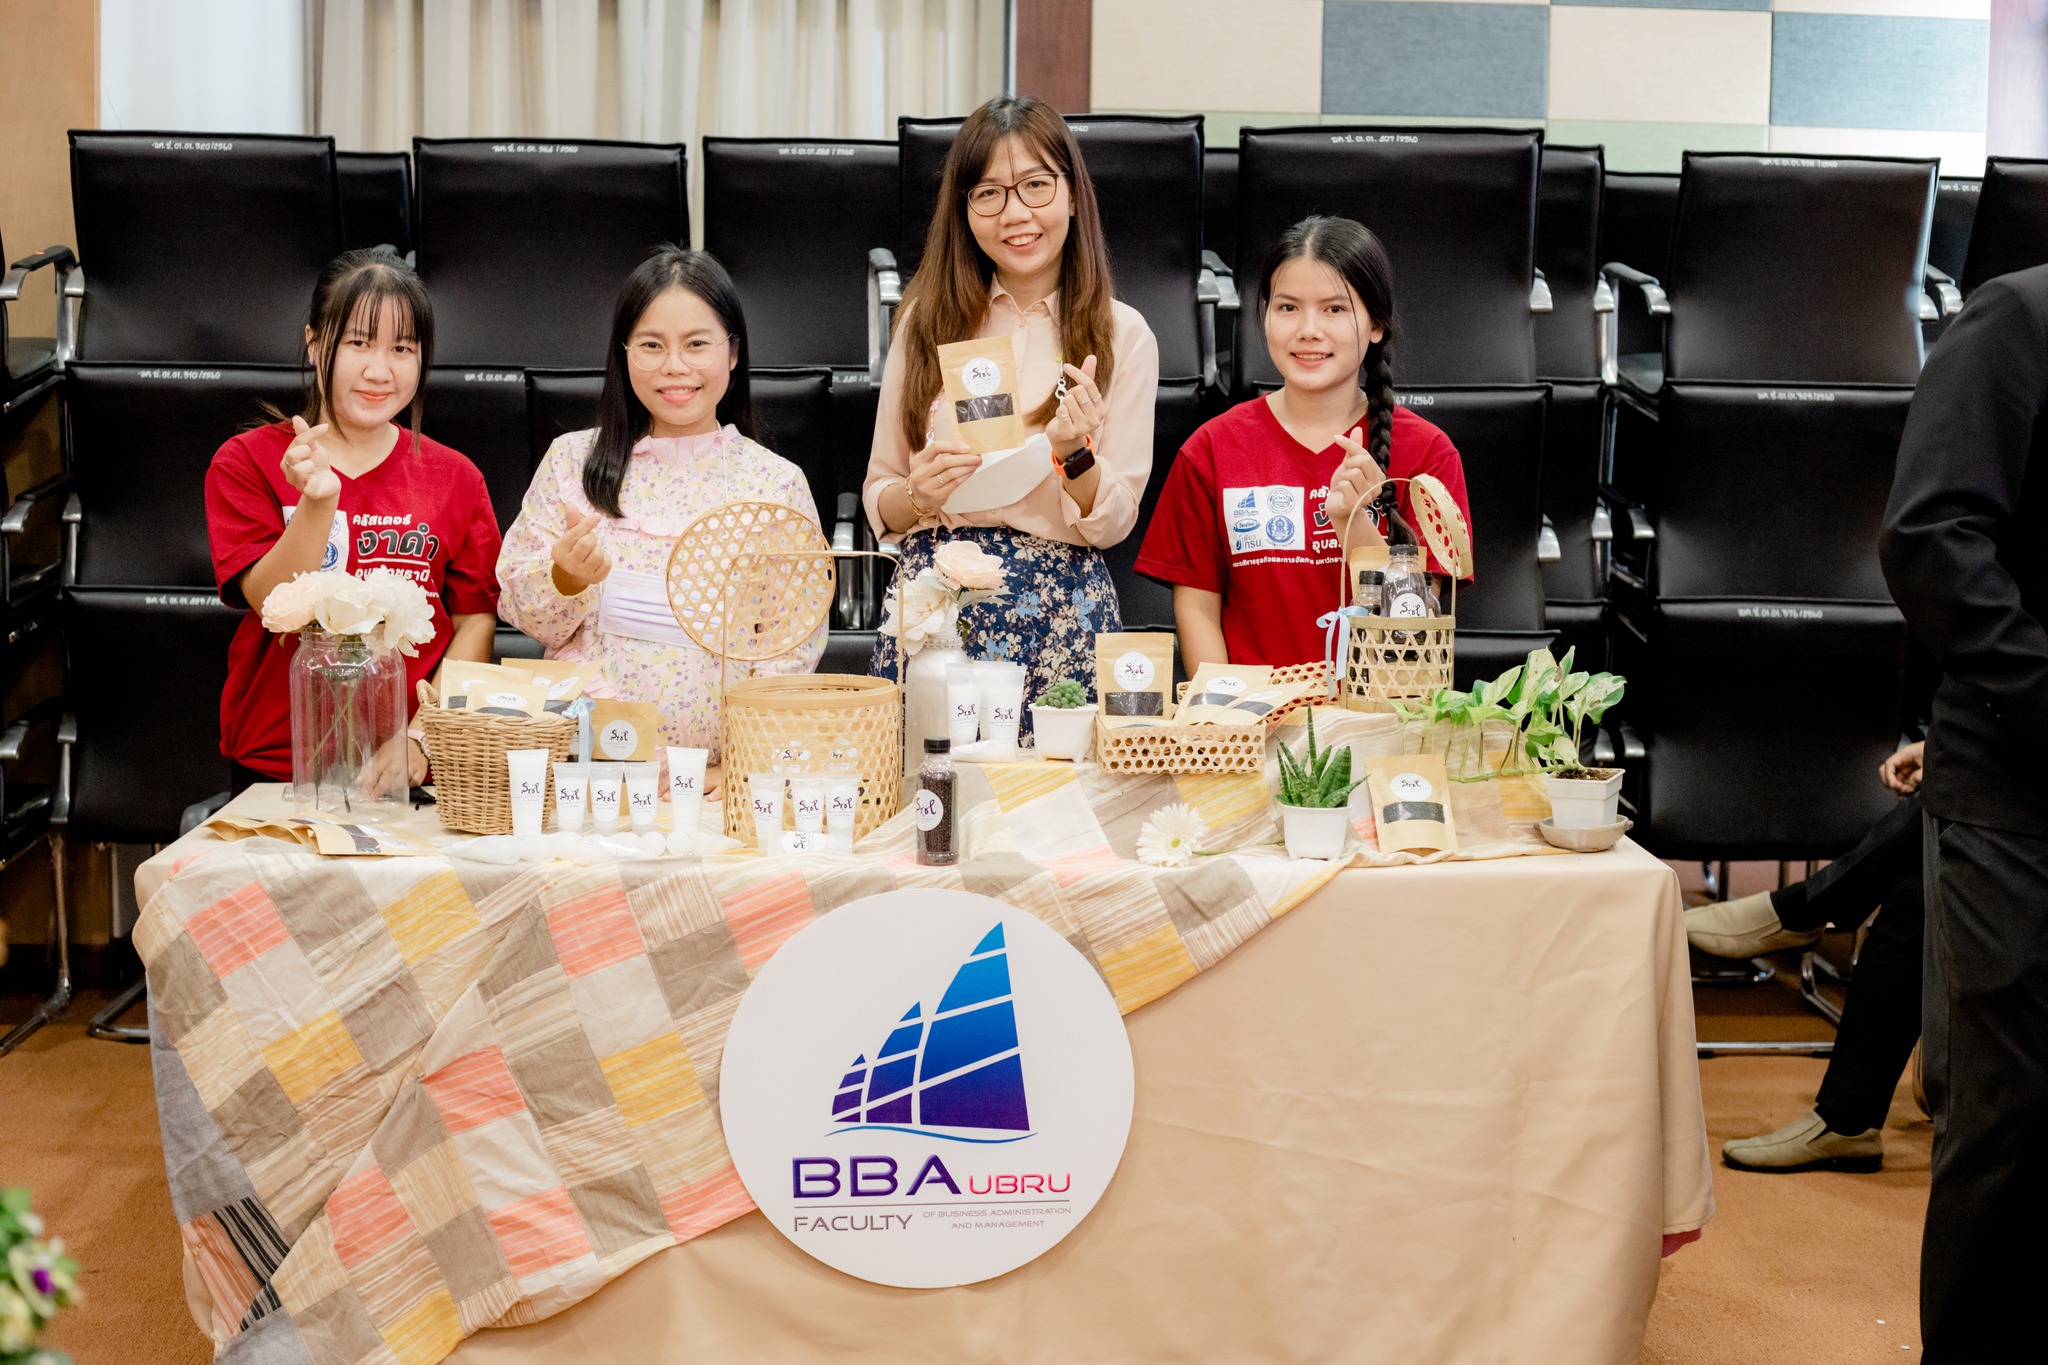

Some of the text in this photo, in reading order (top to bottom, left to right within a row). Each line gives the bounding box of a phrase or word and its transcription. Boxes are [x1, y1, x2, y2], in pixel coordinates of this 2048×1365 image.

[352, 513, 412, 527] คลัสเตอร์
[357, 523, 439, 561] งาดำ
[792, 1153, 1071, 1198] BBA UBRU
[938, 1209, 988, 1218] BUSINESS
[990, 1207, 1072, 1217] ADMINISTRATION
[794, 1213, 913, 1231] FACULTY
[951, 1219, 1046, 1229] AND MANAGEMENT
